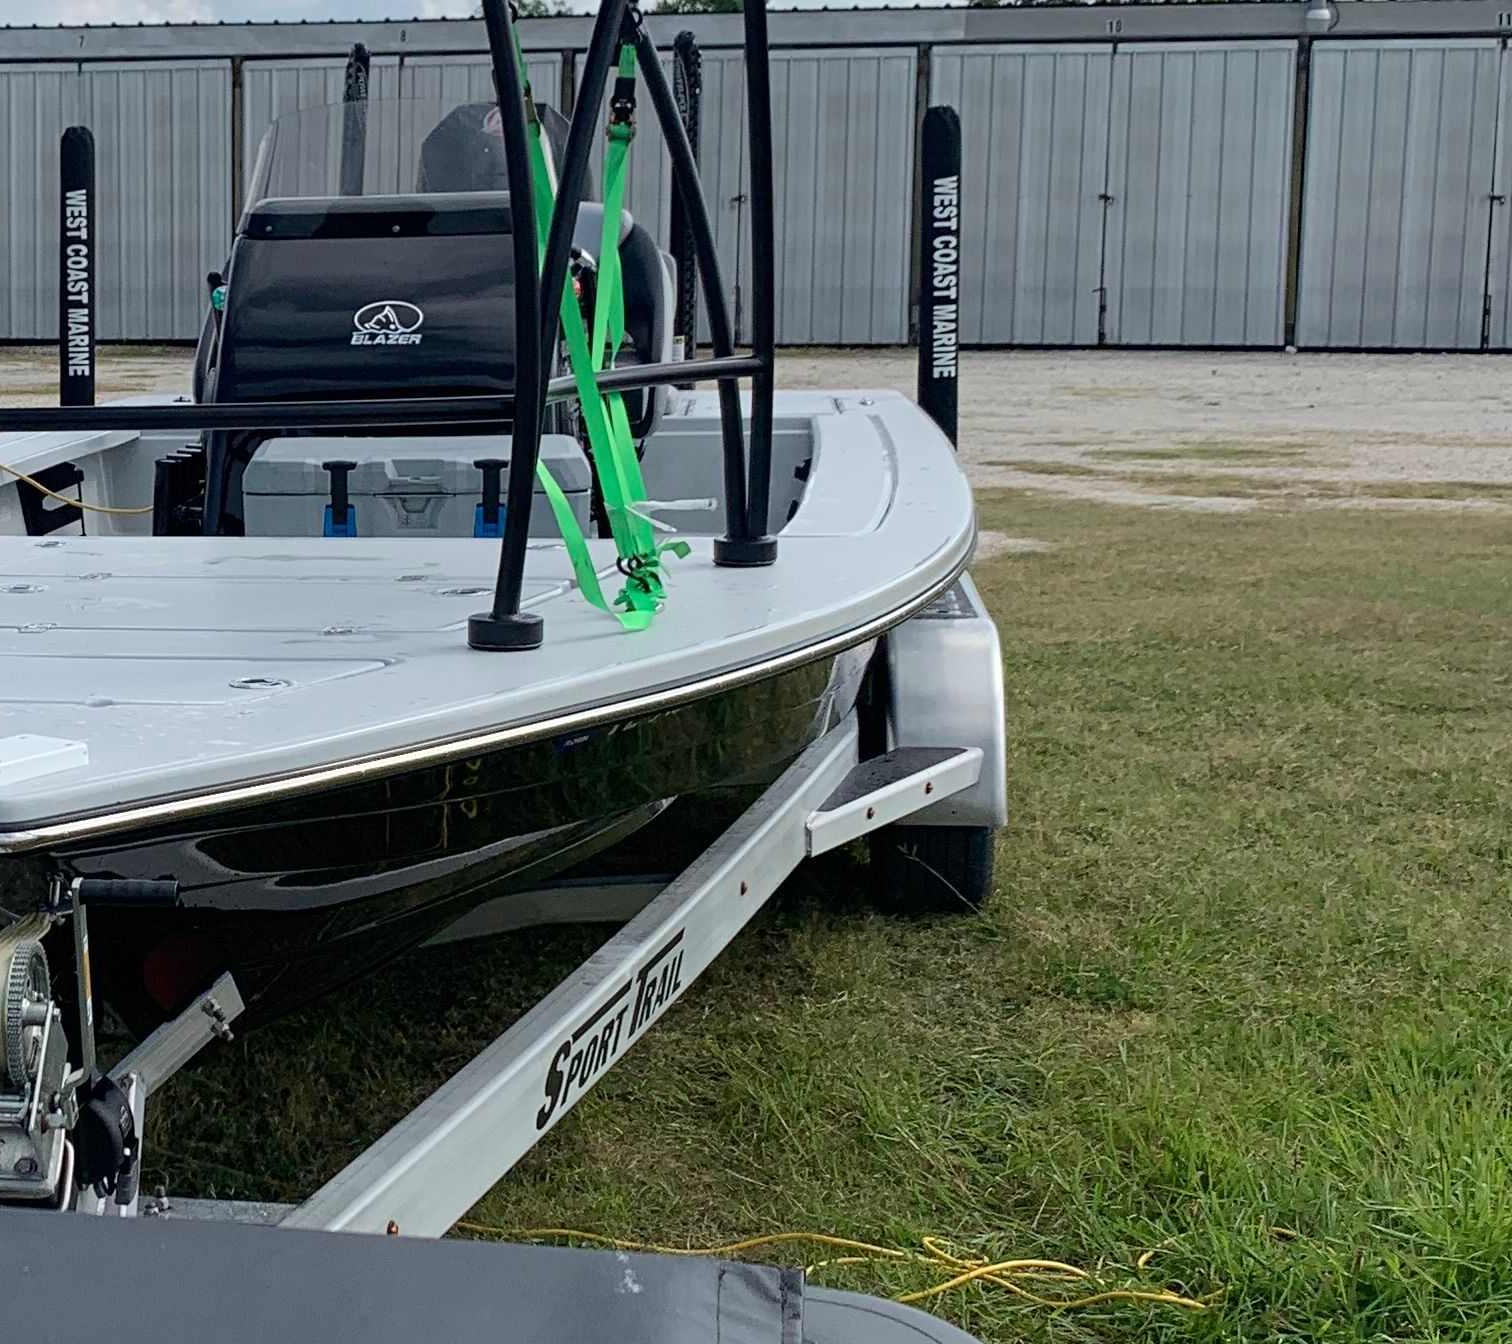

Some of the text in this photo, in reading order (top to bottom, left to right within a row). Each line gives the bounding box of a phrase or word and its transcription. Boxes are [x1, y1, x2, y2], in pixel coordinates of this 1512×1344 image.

[65, 189, 90, 377] WEST COAST MARINE
[351, 333, 423, 345] BLAZER
[932, 175, 959, 378] WEST COAST MARINE
[536, 927, 686, 1130] SPORT TRAIL
